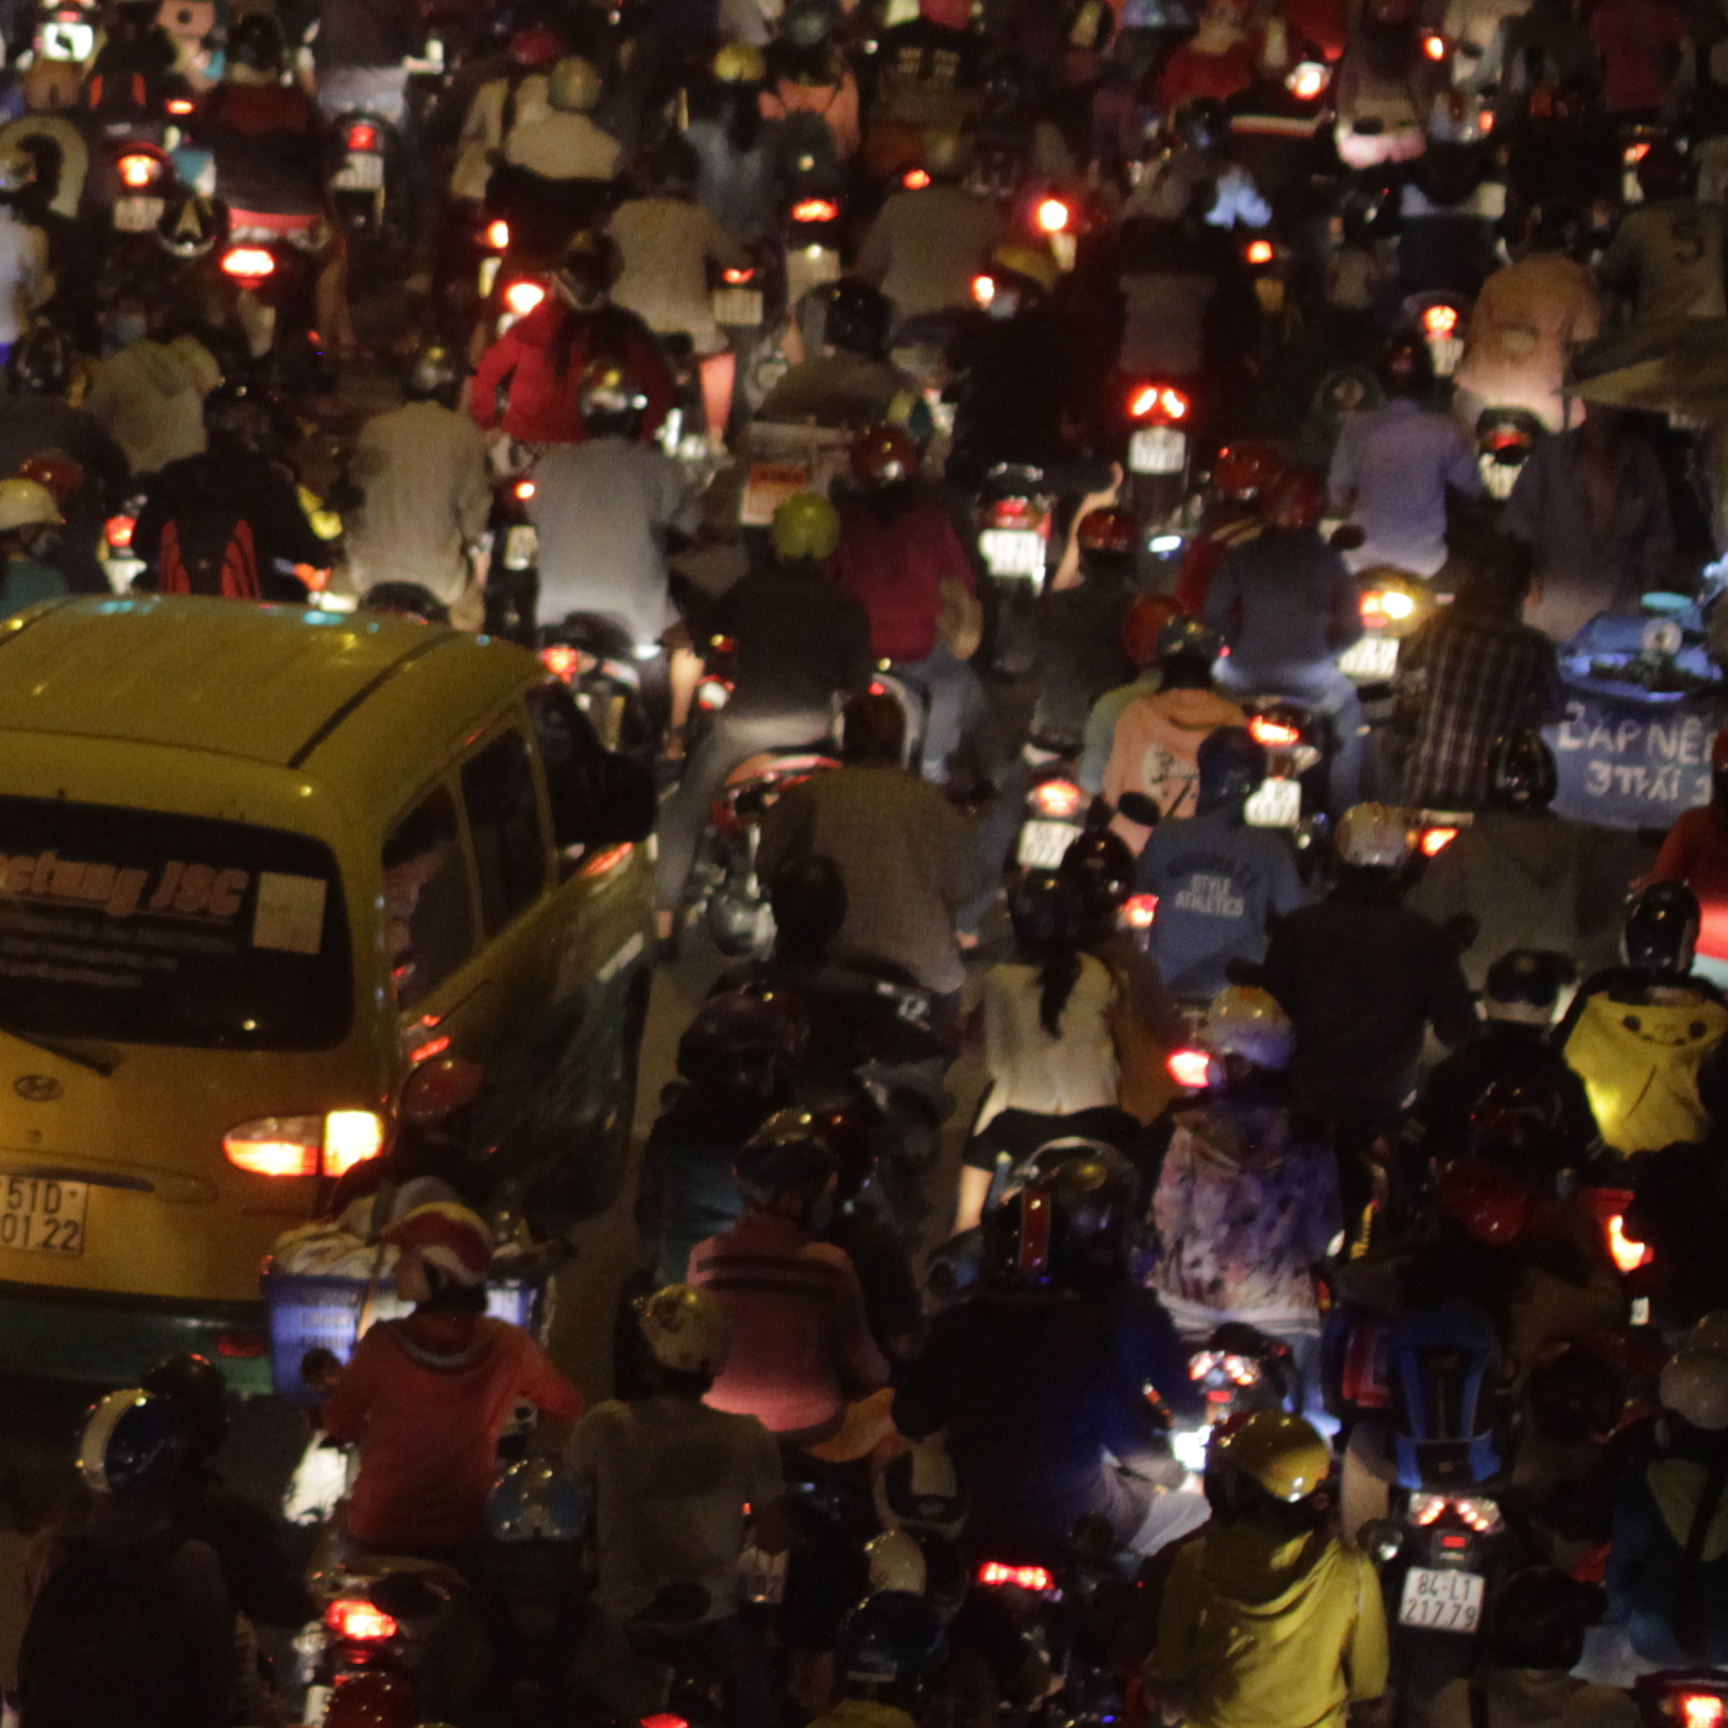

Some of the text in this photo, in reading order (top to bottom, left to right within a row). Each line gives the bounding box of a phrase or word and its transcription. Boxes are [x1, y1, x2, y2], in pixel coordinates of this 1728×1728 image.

[150, 860, 250, 917] JSC
[1175, 889, 1244, 918] ATHLETICS
[8, 1176, 63, 1214] 51D
